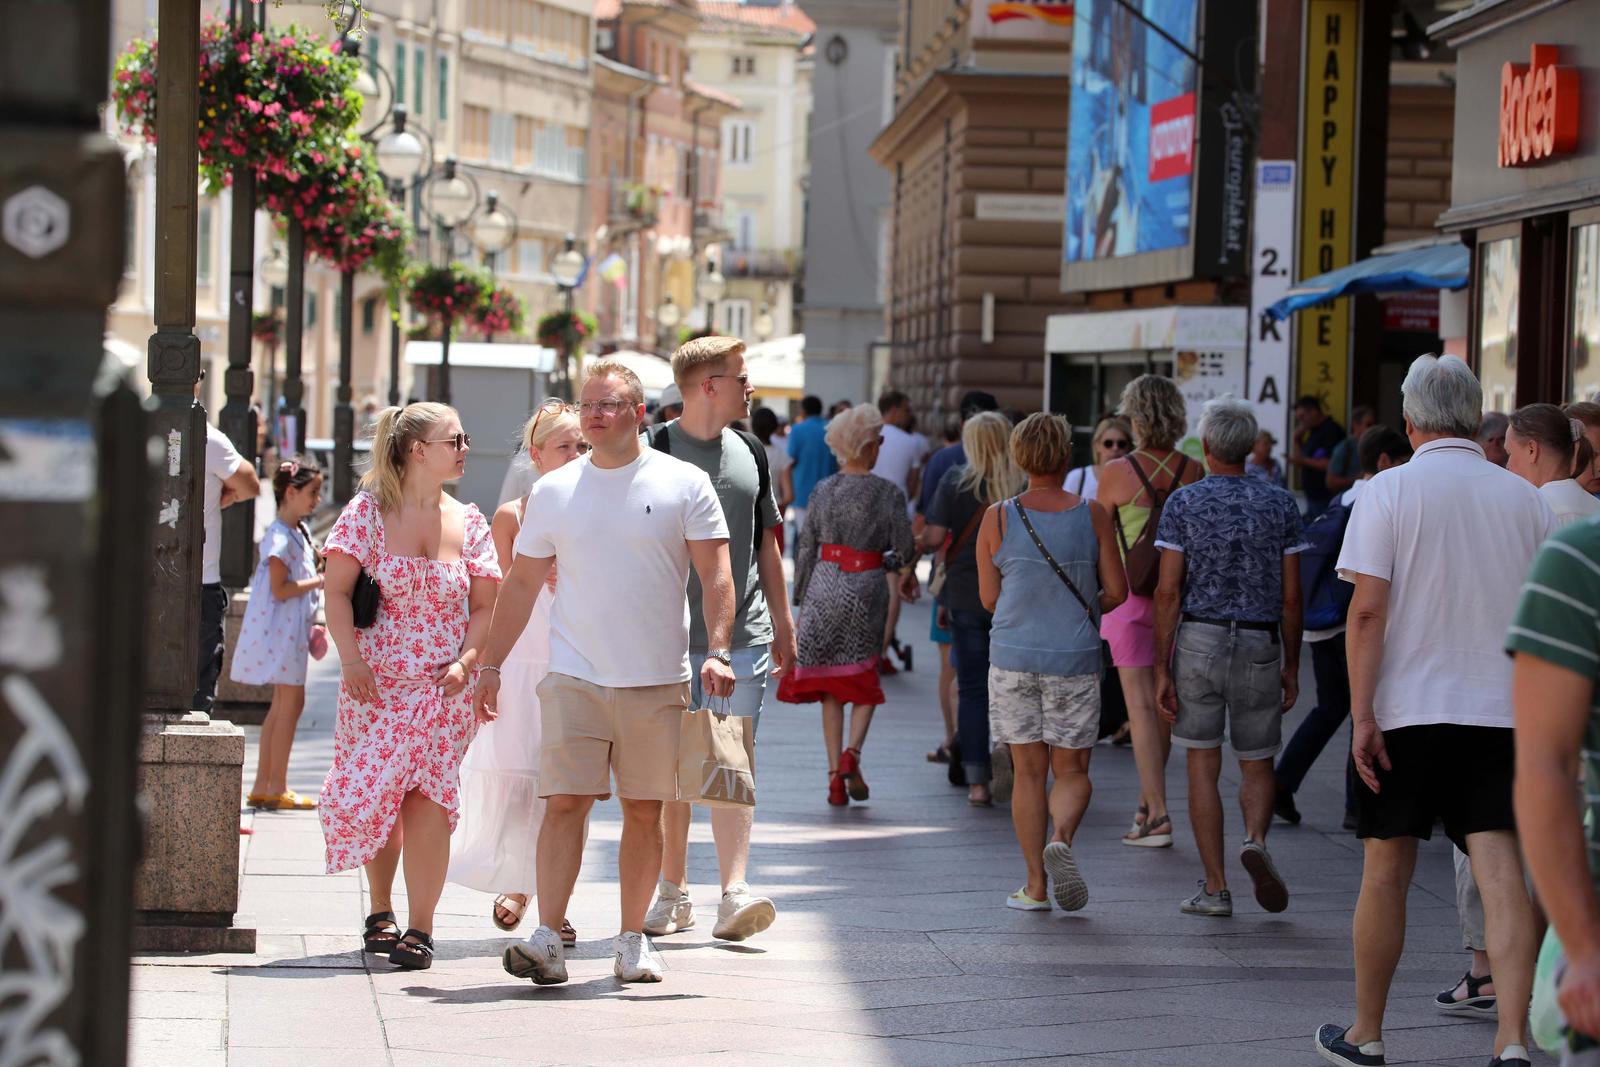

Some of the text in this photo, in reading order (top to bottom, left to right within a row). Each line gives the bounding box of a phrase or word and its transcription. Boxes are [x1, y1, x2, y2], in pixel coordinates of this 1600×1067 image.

[1321, 13, 1342, 188] HAPPY
[1498, 41, 1558, 168] Rodea
[1259, 247, 1288, 277] 2.
